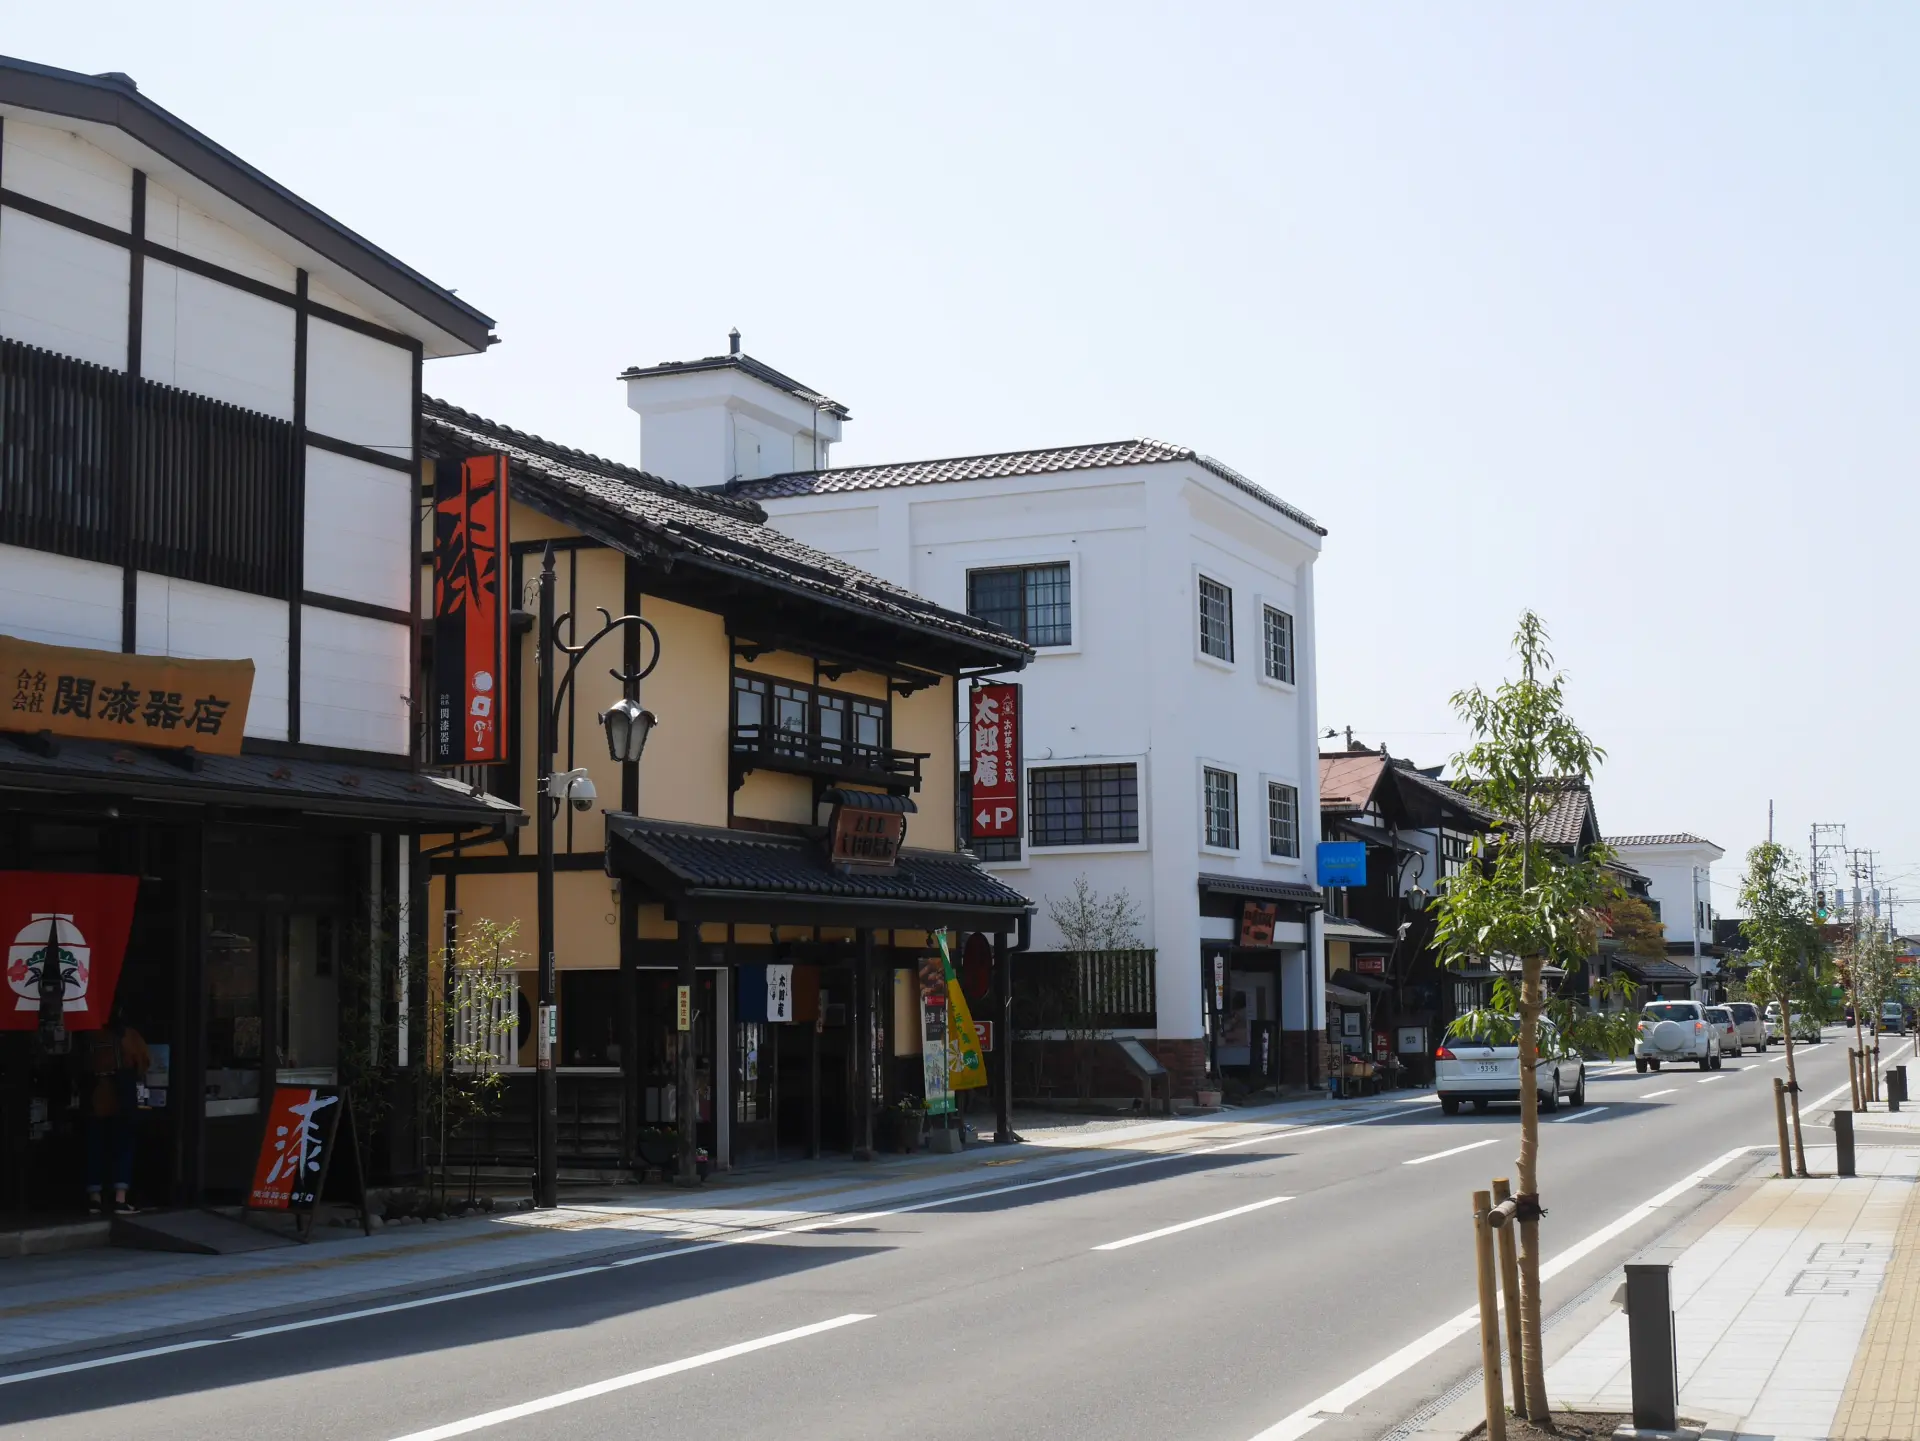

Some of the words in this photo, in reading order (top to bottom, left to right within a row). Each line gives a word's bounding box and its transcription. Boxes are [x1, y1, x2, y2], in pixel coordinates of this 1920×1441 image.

[436, 462, 495, 618] 漆
[51, 675, 231, 735] 関漆器店
[440, 708, 450, 755] 関漆器店
[974, 693, 999, 787] 太郎庵
[995, 807, 1013, 829] P
[266, 1089, 339, 1184] 漆
